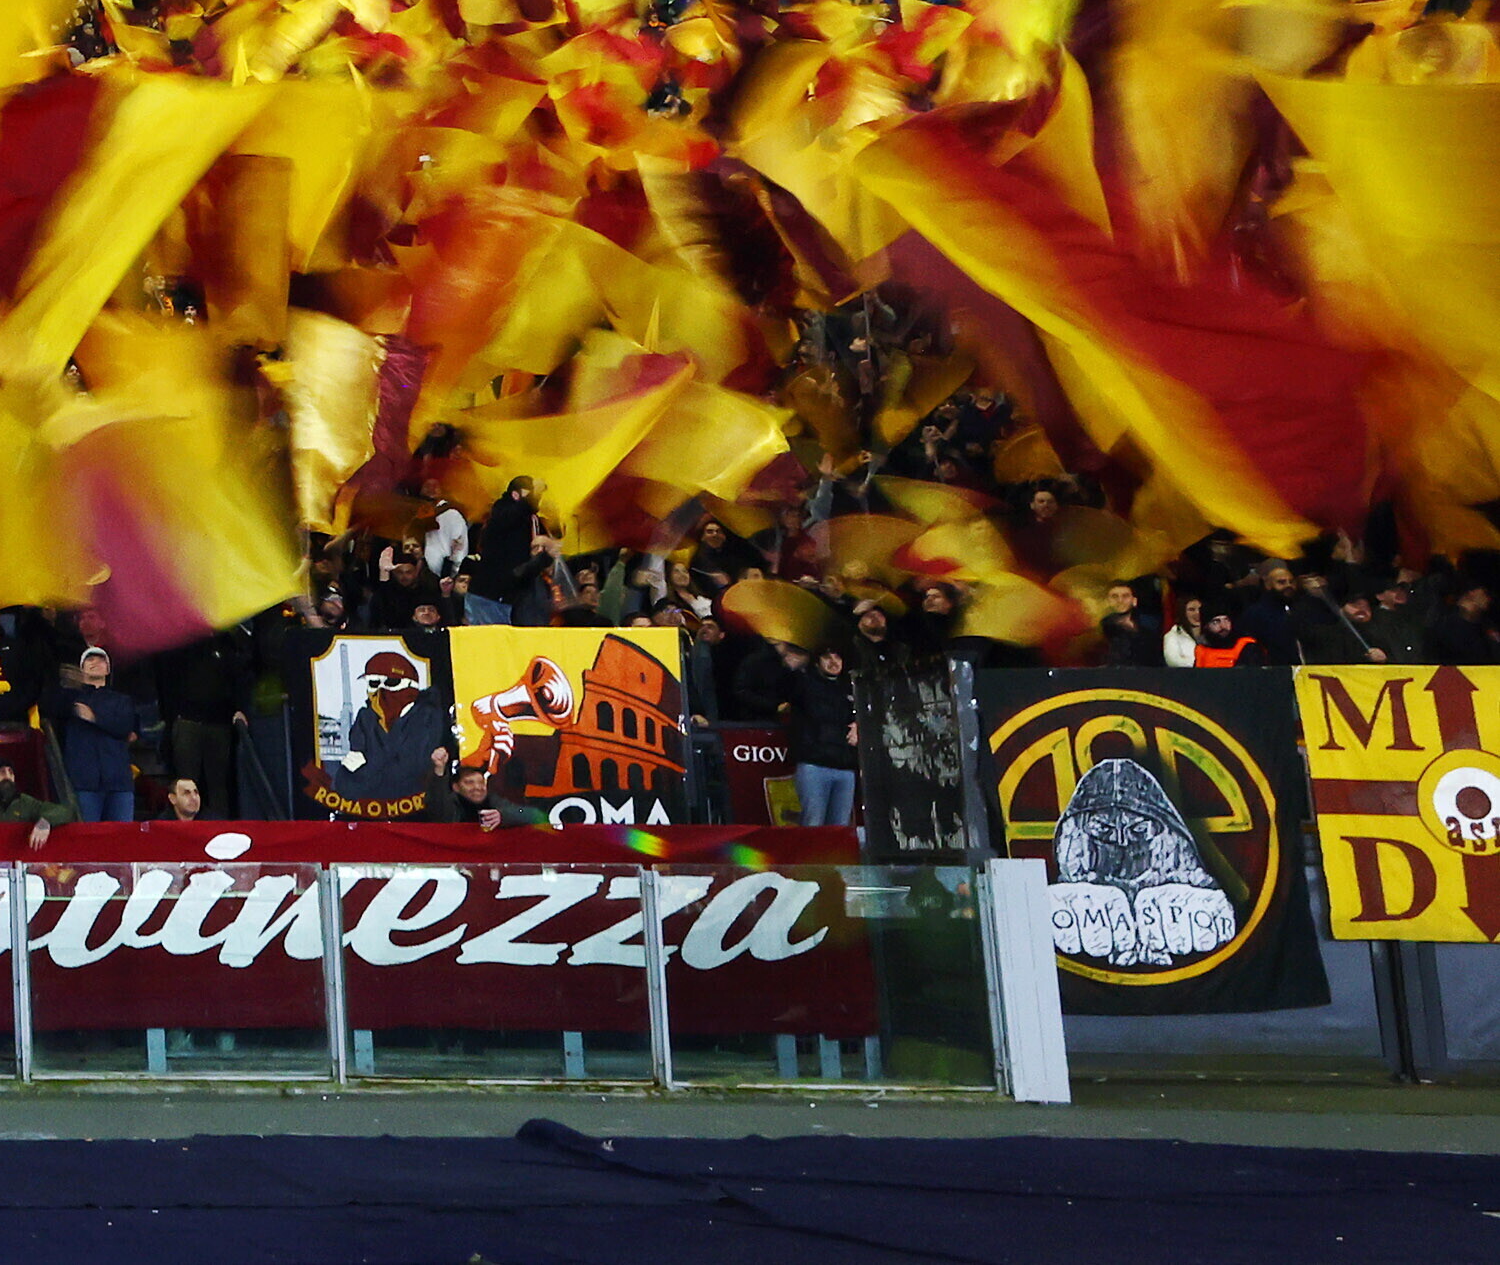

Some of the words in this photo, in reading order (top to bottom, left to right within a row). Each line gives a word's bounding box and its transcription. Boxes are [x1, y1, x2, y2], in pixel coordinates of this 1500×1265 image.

[732, 744, 789, 764] GIOV
[313, 785, 362, 815] ROMA
[366, 800, 382, 816] O
[548, 796, 662, 829] OMA
